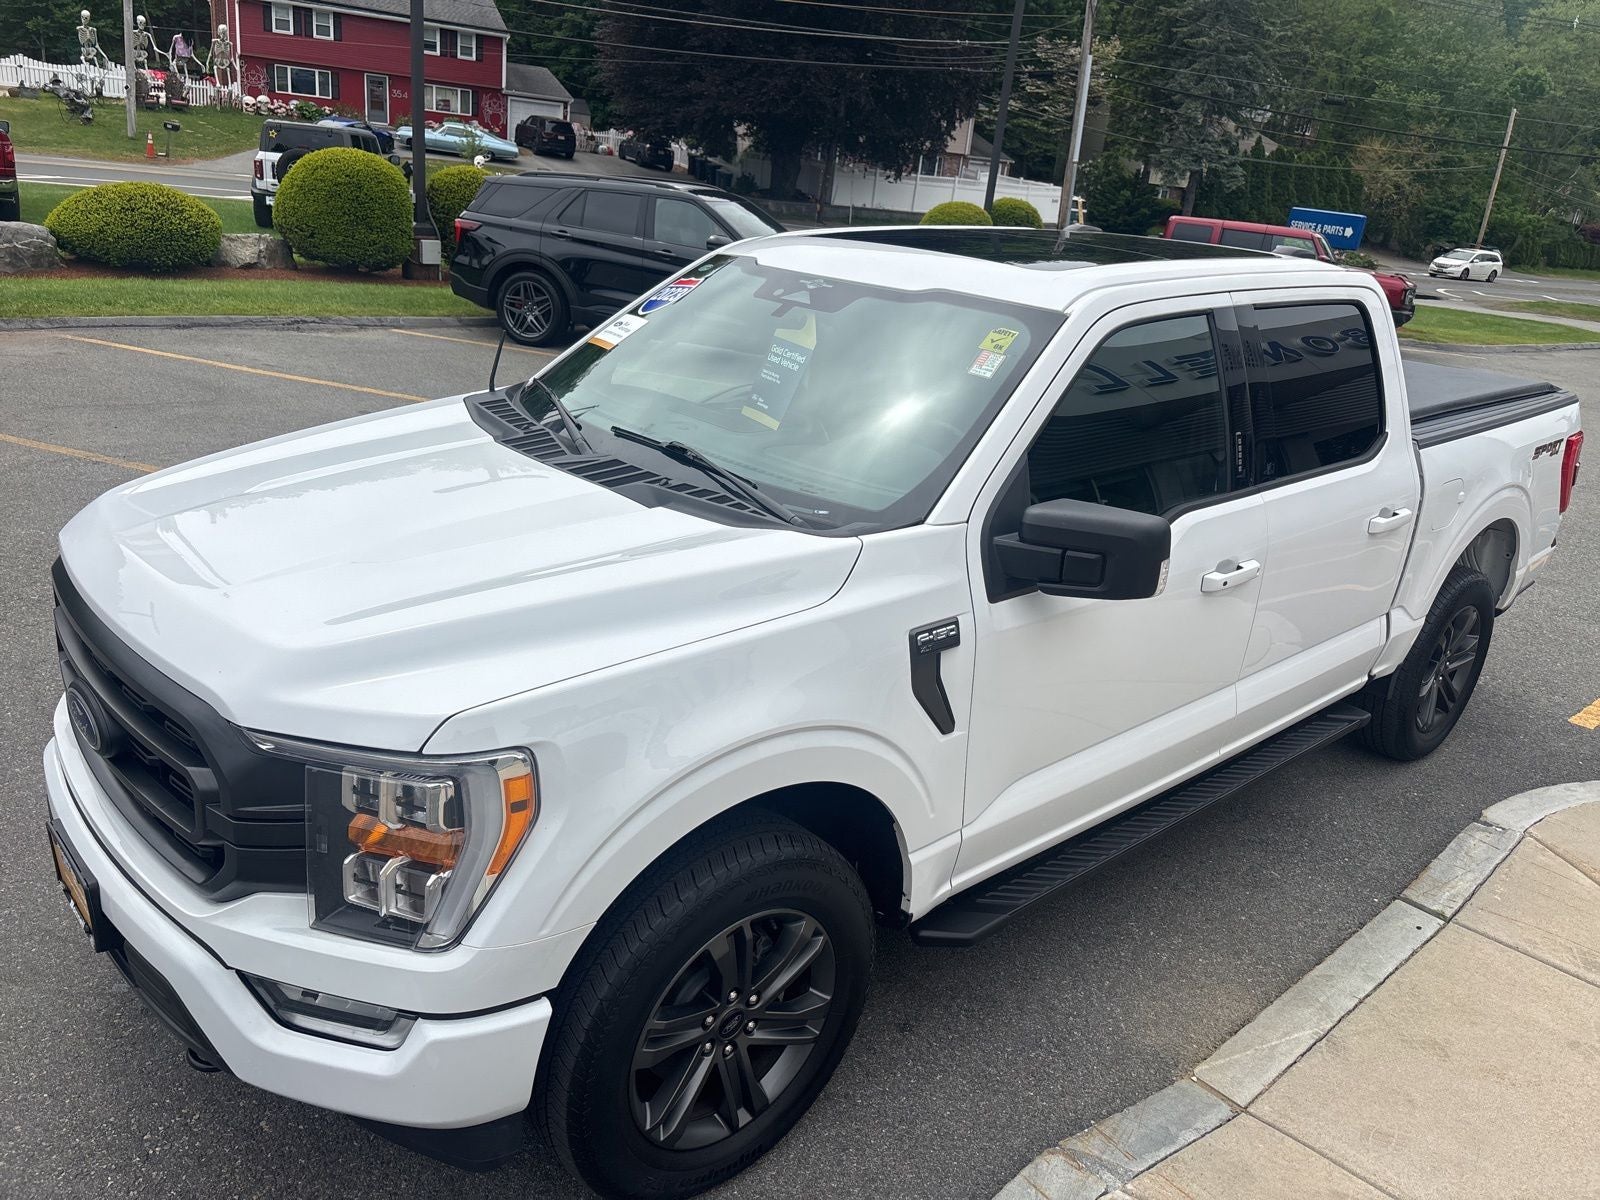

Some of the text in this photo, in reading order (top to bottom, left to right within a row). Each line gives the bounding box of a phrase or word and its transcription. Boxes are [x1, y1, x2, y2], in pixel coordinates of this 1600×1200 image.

[1290, 220, 1344, 236] SERVICE & PARTS
[768, 352, 799, 371] Used Vehicle
[771, 344, 806, 364] Gold Certified
[1532, 438, 1564, 460] SPORT
[917, 624, 958, 646] F-150
